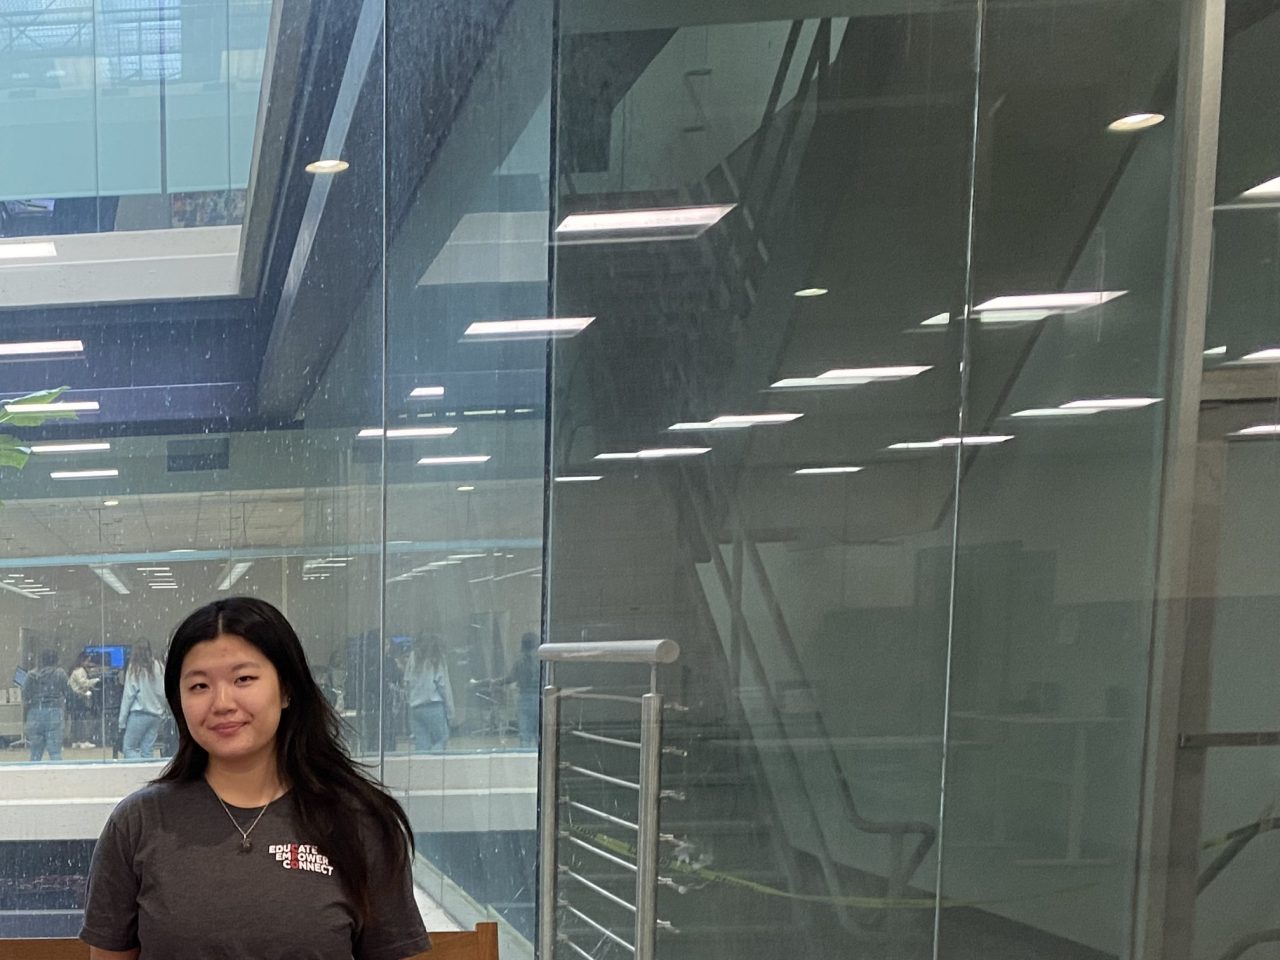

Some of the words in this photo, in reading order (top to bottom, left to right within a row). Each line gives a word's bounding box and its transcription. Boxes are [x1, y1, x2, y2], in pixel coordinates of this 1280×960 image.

[268, 843, 318, 855] EDUCATE
[275, 852, 329, 866] EMPOWER
[282, 860, 334, 876] CONNECT
